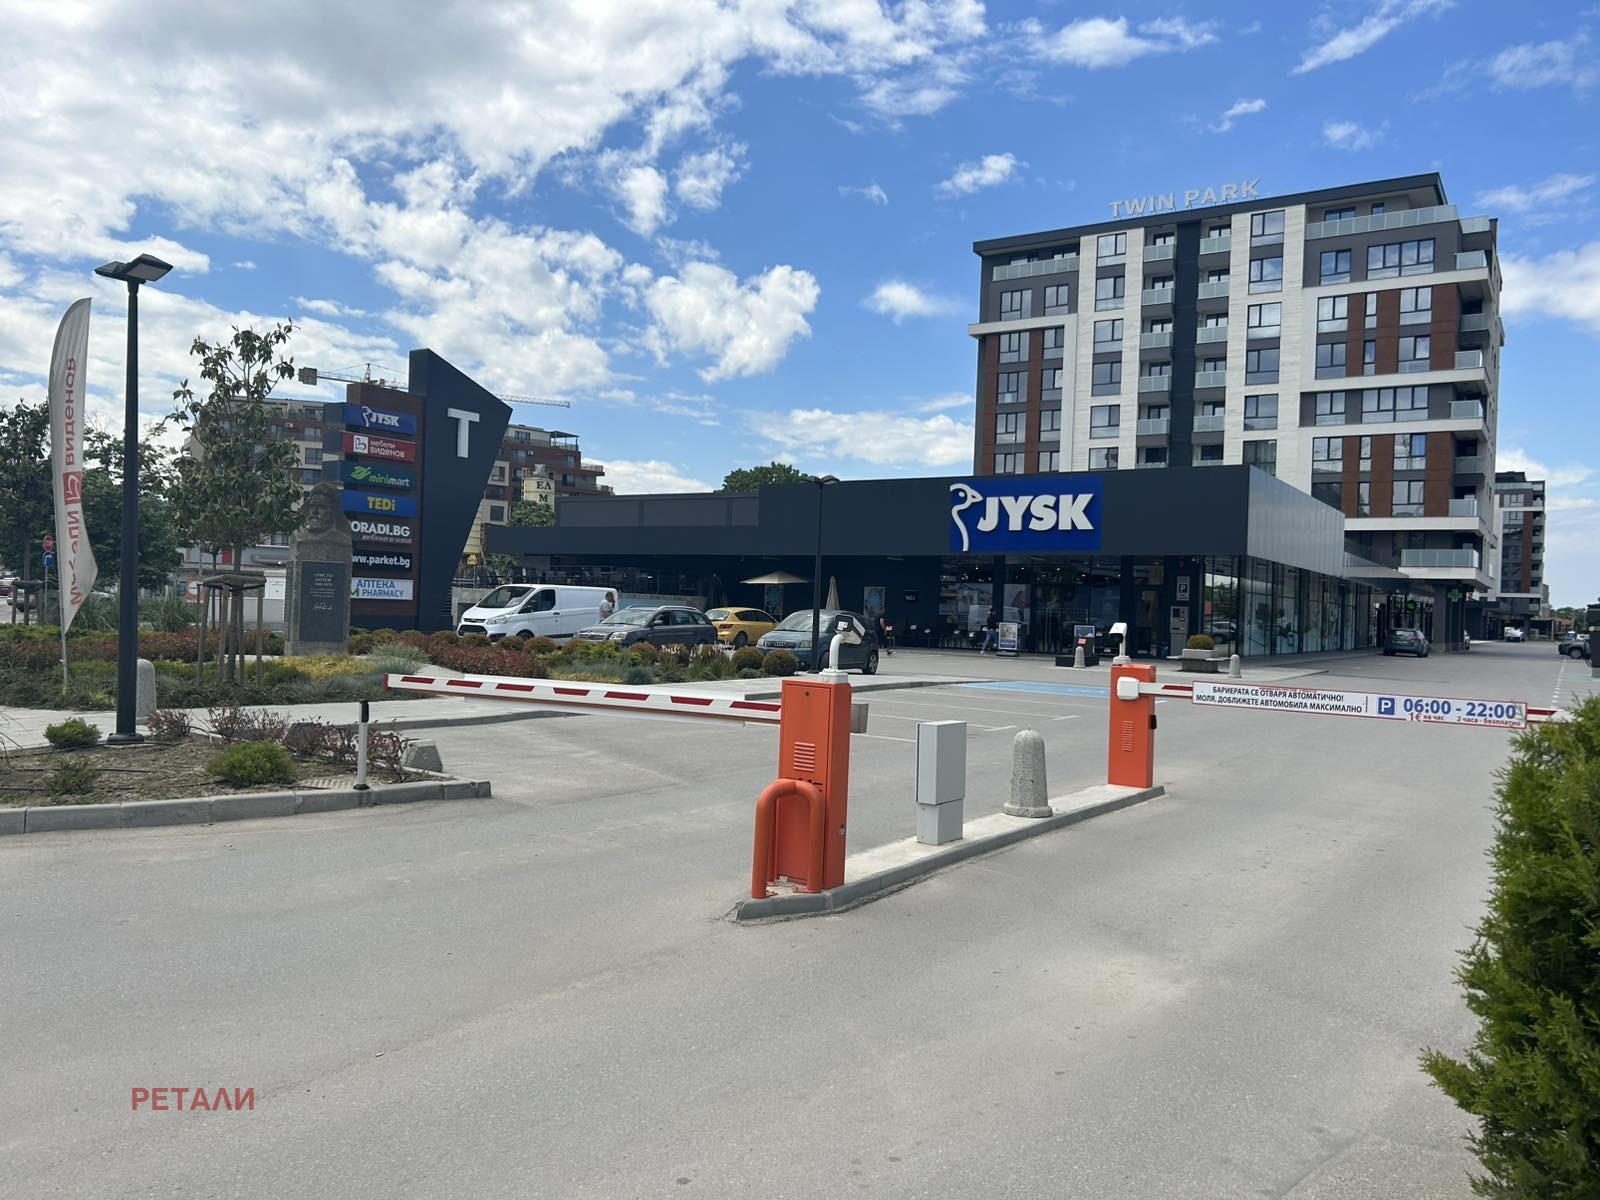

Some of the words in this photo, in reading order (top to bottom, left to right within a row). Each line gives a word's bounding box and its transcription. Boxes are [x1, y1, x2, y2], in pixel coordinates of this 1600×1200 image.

[1108, 192, 1175, 219] TWIN
[1184, 176, 1263, 208] PARK
[370, 412, 400, 427] JYSK
[447, 407, 480, 458] T
[368, 474, 410, 487] minimart
[367, 496, 396, 511] TEDi
[976, 493, 1095, 532] JYSK
[348, 520, 411, 537] ORADI.BG
[356, 579, 396, 589] АПТЕКА
[362, 589, 404, 598] PHARMACY
[1212, 686, 1250, 696] БАРИЕРАТА
[1250, 689, 1259, 697] СЕ
[1259, 690, 1287, 698] ОТВАРЯ
[1288, 692, 1344, 702] АВТОМАТИЧНО!
[1196, 694, 1217, 702] МОЛЯ,
[1217, 696, 1259, 706] ДОБЛИЖЕТЕ
[1260, 699, 1308, 709] АВТОМОБИЛА
[1309, 702, 1363, 713] МАКСИМАЛНО
[1381, 701, 1392, 713] P
[1403, 698, 1452, 715] 06:00
[1465, 702, 1517, 719] 22:00
[1408, 712, 1422, 721] 1€
